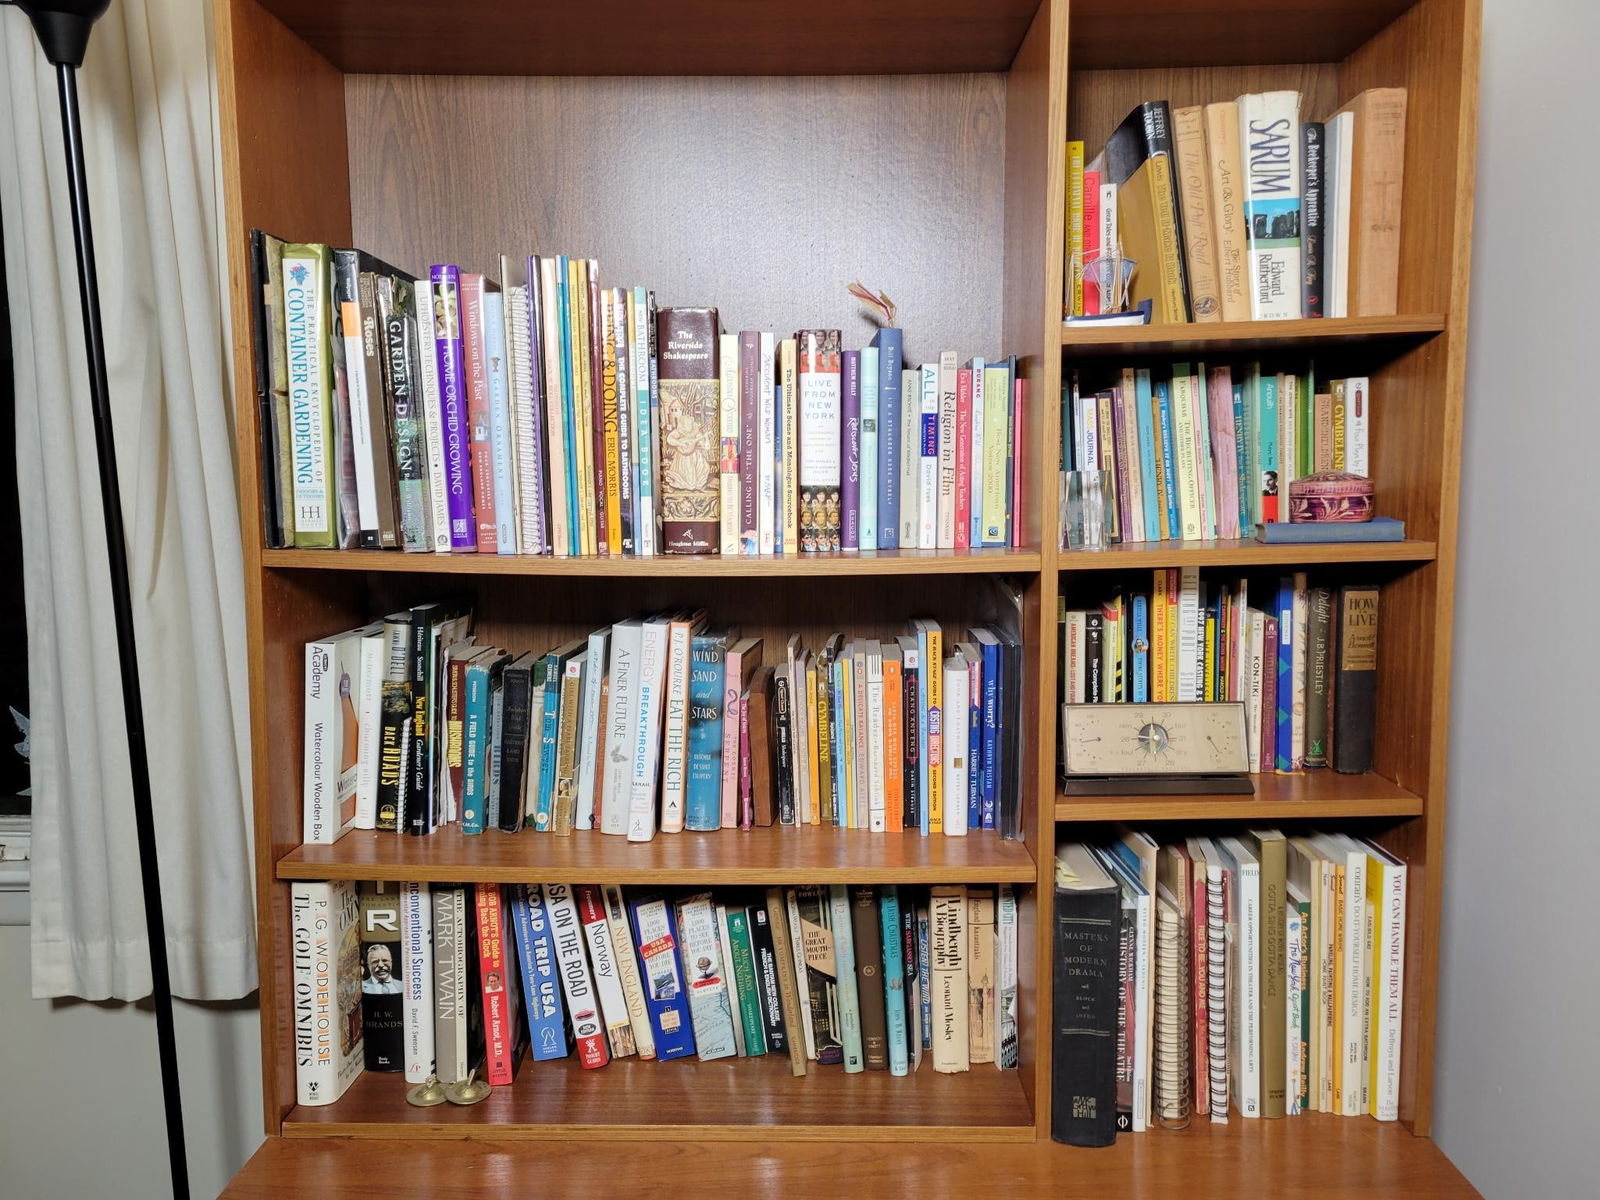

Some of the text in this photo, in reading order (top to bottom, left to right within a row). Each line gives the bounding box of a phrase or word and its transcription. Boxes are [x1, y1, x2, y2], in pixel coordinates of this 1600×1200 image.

[1154, 107, 1165, 139] JEFFREY
[1249, 119, 1291, 195] SARUM
[1084, 177, 1096, 220] Camille
[1308, 144, 1319, 227] Beekeeper's Apprentice
[1272, 261, 1285, 296] Edward
[364, 317, 375, 356] Roses
[468, 300, 483, 400] Windows on the Past
[636, 324, 648, 382] BATHROOM
[664, 352, 708, 361] Shakespeare
[668, 341, 703, 350] Riverside
[678, 331, 693, 339] The
[288, 288, 312, 484] CONTAINER GARDENING
[389, 321, 411, 471] GARDEN DESIGN
[603, 374, 617, 432] DOING
[924, 369, 936, 400] ALL
[312, 383, 321, 464] ENCYCLOPEDIA
[420, 296, 445, 525] UPHOLSTERY TECHNIQUES PROJECTS DAVID JAMES
[446, 388, 458, 431] ORCHID
[449, 434, 462, 494] GROWING
[621, 439, 627, 449] TO
[941, 391, 955, 496] Religion in Film
[315, 470, 322, 482] OF
[608, 460, 617, 496] MORRIS
[641, 447, 649, 487] BOOK
[1349, 614, 1377, 626] LIVE
[1350, 598, 1375, 610] HOW
[1313, 591, 1329, 695] Delight J.B. PRIESTLEY
[673, 648, 682, 694] O'ROURKE
[692, 670, 717, 682] SAND
[696, 687, 712, 698] and
[416, 696, 425, 709] New
[615, 648, 630, 738] A FINER FUTURE
[636, 632, 655, 777] ENERGY BREAKTHROUGH
[670, 700, 683, 723] EAT
[691, 707, 717, 719] STARS
[985, 680, 995, 728] why worry?
[311, 646, 323, 840] Academy Watercolour Wooden Box
[414, 710, 425, 735] England
[668, 728, 681, 752] THE
[818, 701, 828, 762] CYMBELINE
[930, 711, 940, 733] CASTING
[930, 736, 940, 764] DIRECTORS
[667, 758, 680, 790] RICH
[366, 909, 399, 932] R
[933, 900, 947, 966] A Biography
[948, 900, 961, 966] Lindbergh
[437, 893, 454, 1019] MARK TWAIN
[526, 884, 556, 1017] ROAD TRIP USA
[554, 908, 588, 997] ON THE ROAD
[592, 923, 612, 978] Norway
[1064, 956, 1108, 966] MODERN
[1079, 944, 1094, 953] OF
[1389, 875, 1401, 1022] YOU CAN HANDLE THEM ALL
[294, 894, 312, 1066] The GOLF OMNIBUS
[315, 902, 330, 1066] P. G. WODEHOUSE
[412, 959, 422, 1000] Success
[615, 926, 642, 1017] NEW ENGLAND
[1068, 968, 1104, 979] DRAMA
[458, 1006, 464, 1018] OF
[490, 996, 502, 1056] Robert Arnot, M.D.
[943, 976, 954, 1041] Leonard Mosley
